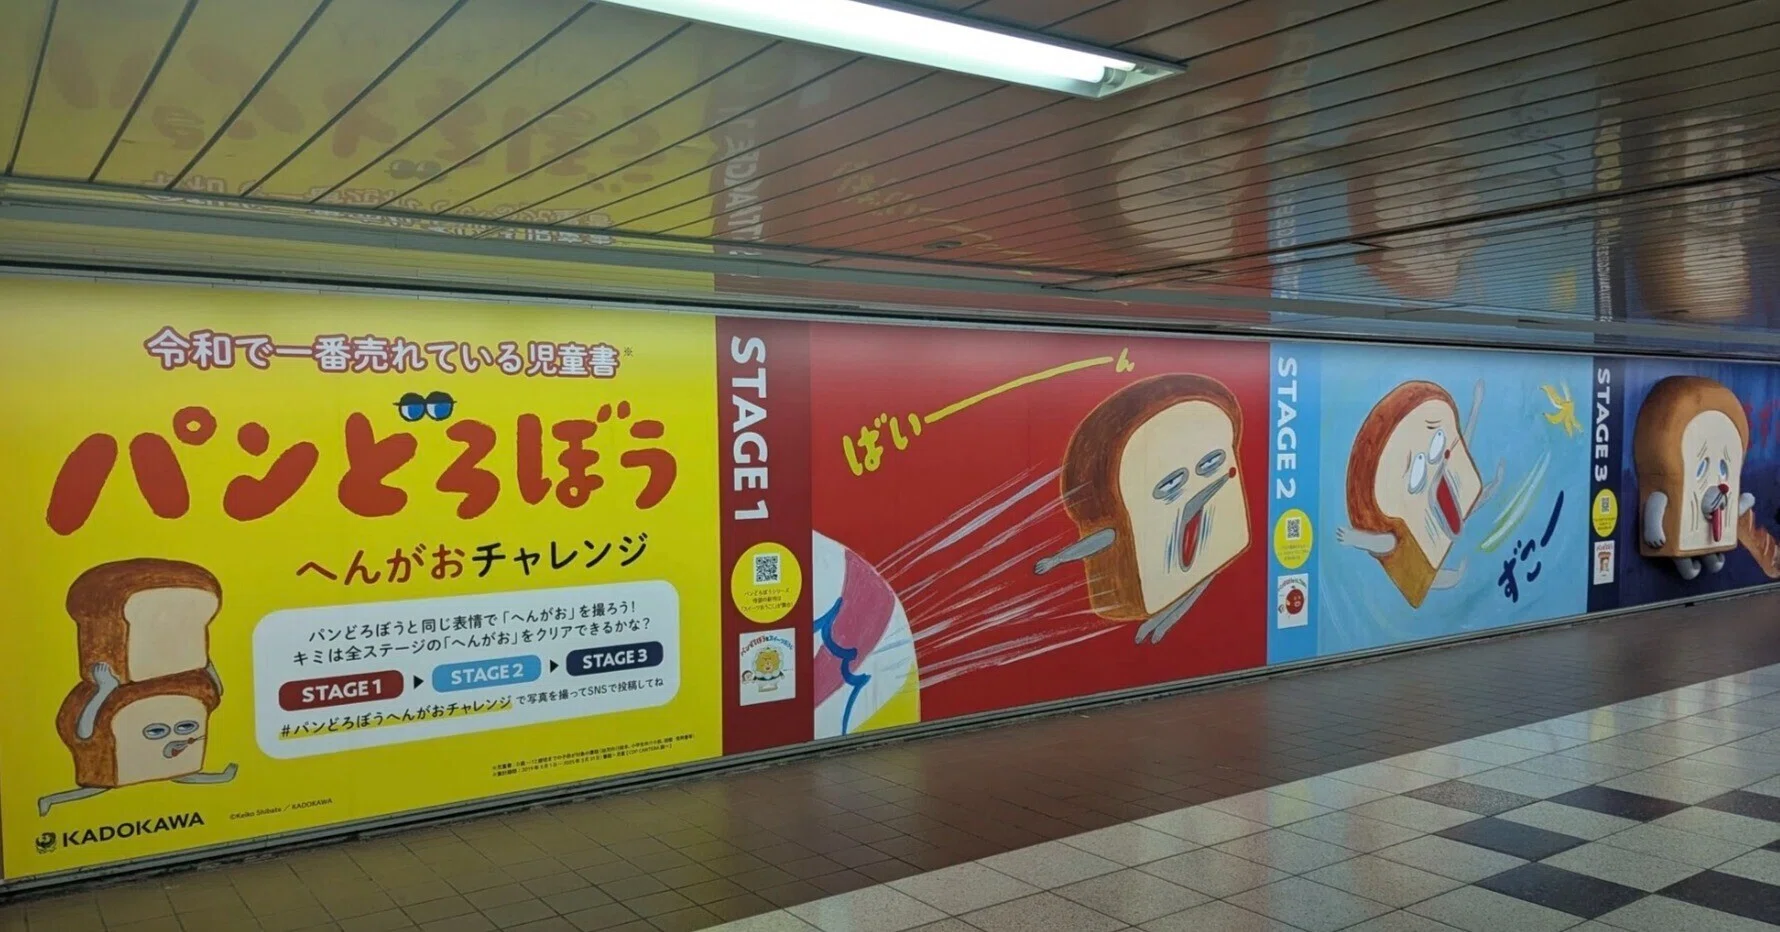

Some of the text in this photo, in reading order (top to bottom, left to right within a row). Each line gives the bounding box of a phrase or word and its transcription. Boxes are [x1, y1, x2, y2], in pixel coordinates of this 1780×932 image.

[144, 326, 619, 378] 令和で一番売れている児童書
[731, 336, 769, 520] STAGE 1
[1276, 357, 1298, 500] STAGE 2
[1594, 368, 1611, 482] STAGE 3
[46, 391, 677, 536] パンどろぼう
[296, 532, 649, 586] へんがおチャレンジ
[293, 618, 650, 666] キミは全ステージの「へんがお」をクリアできるかな？
[309, 601, 635, 642] パンどろぼうと同じ表情で「へんがお」を撮ろう！
[451, 663, 524, 685] STAGE 2
[582, 649, 648, 670] STAGE 3
[302, 679, 382, 703] STAGE 1
[291, 798, 333, 811] KADOKAWA
[63, 812, 205, 848] KADOKAWA
